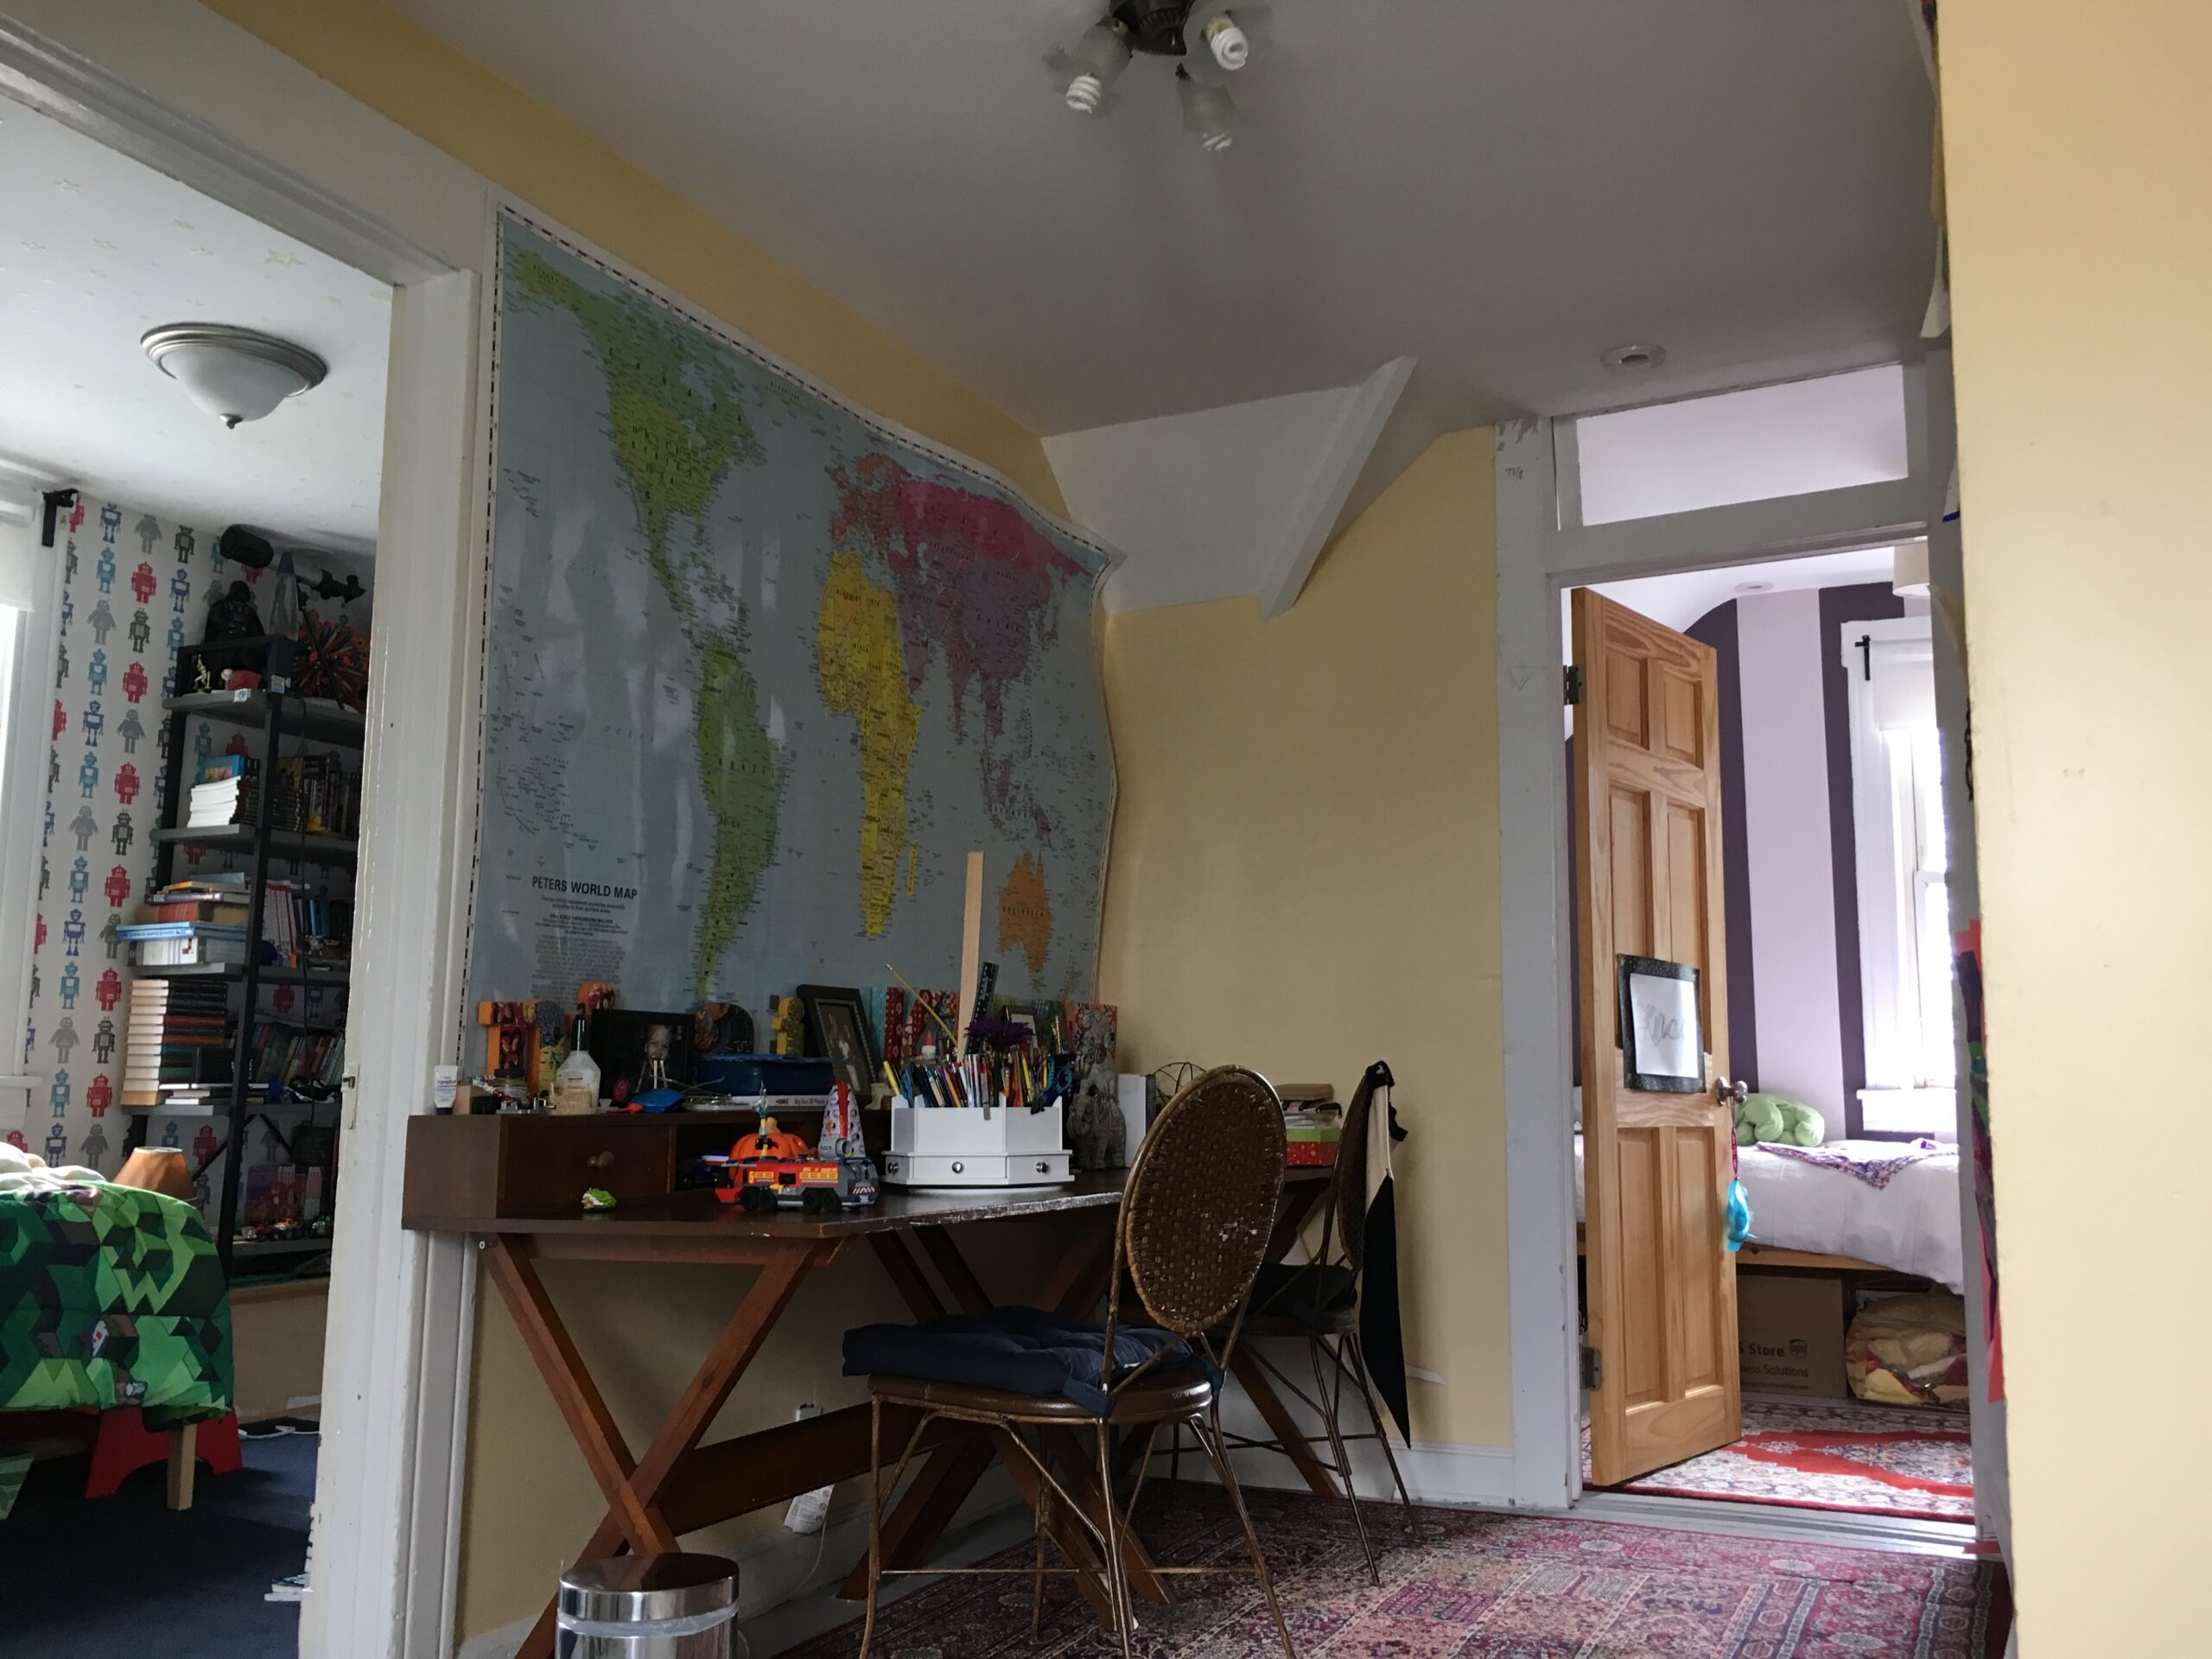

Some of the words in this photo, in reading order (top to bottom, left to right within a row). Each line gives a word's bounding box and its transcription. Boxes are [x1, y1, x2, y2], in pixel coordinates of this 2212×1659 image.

[532, 876, 568, 892] PETERS
[571, 881, 611, 897] WORLD
[613, 887, 638, 899] MAP
[1749, 1343, 1784, 1357] Store
[1764, 1364, 1808, 1377] Solutions
